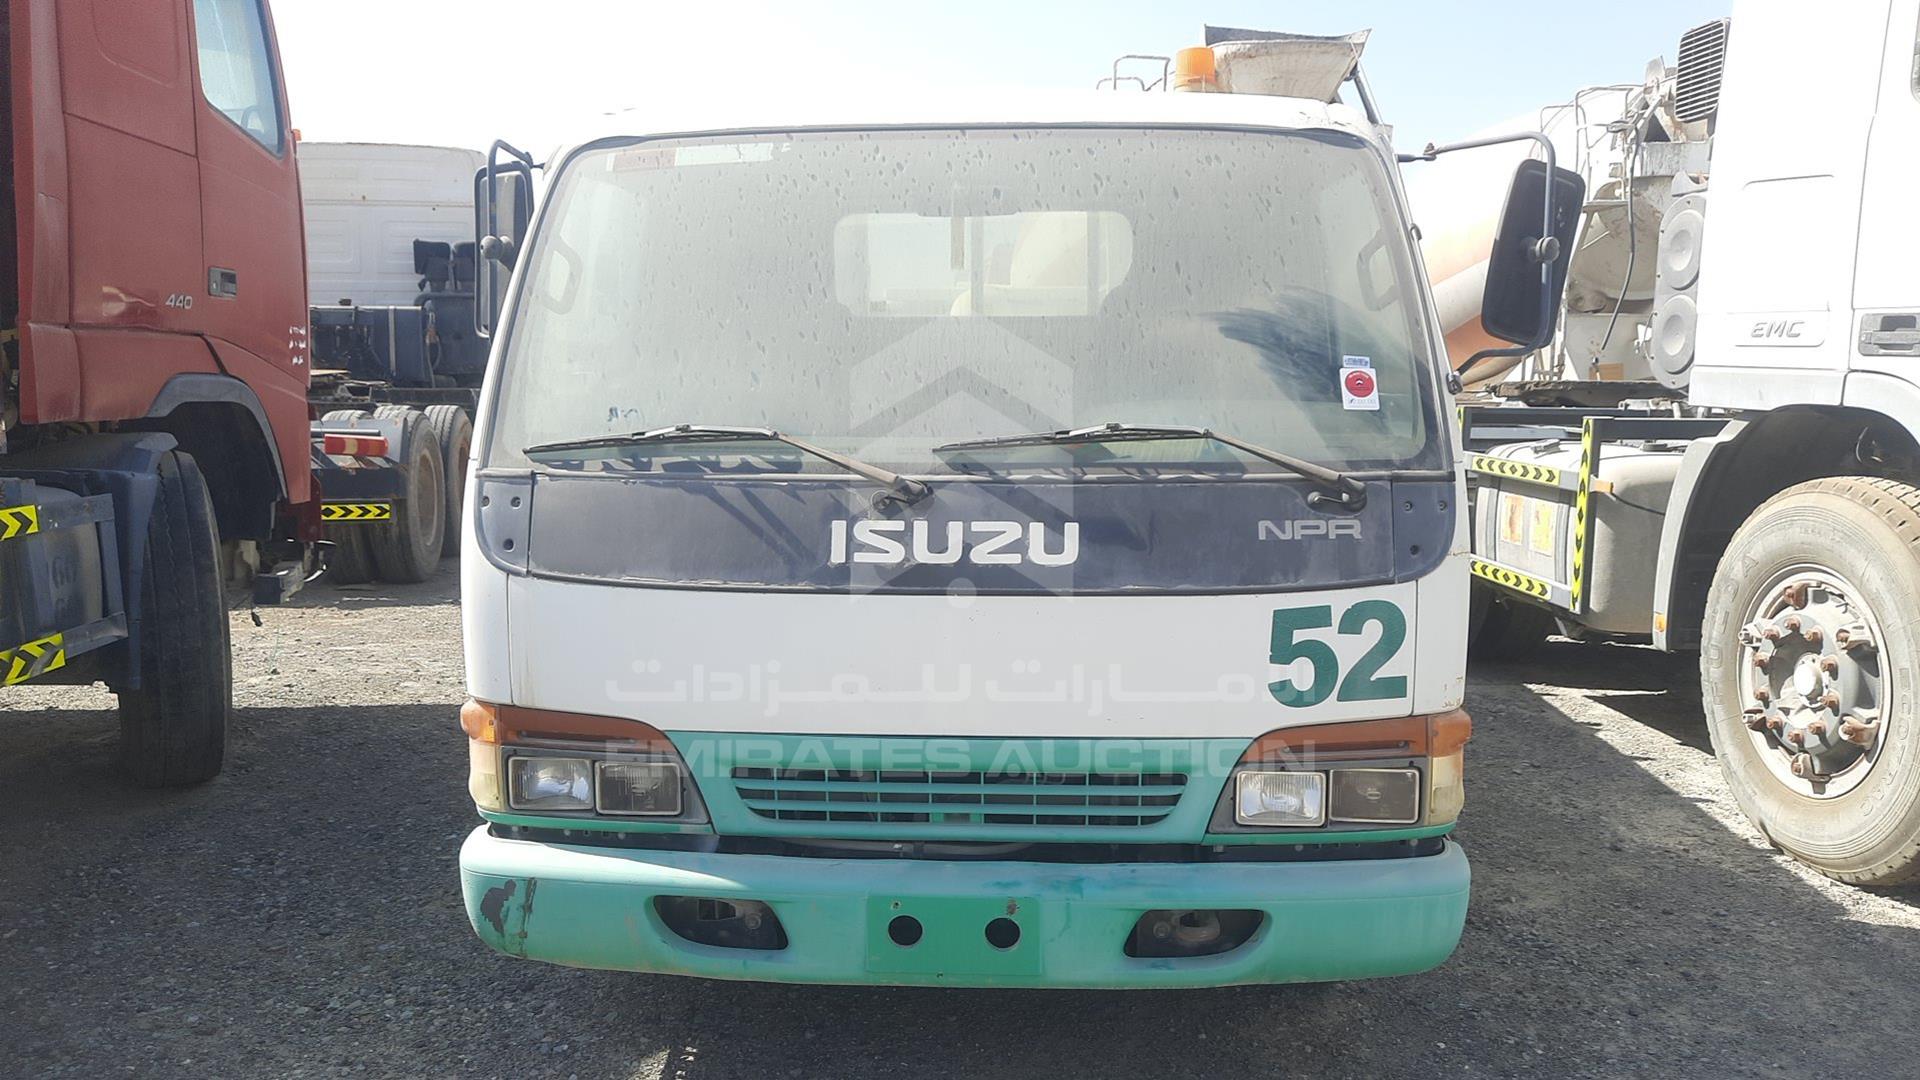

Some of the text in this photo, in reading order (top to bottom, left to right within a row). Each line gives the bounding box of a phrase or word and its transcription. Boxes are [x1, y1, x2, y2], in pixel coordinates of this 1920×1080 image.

[165, 294, 193, 310] 440
[1751, 319, 1805, 338] EMC
[1257, 519, 1363, 541] NPR
[830, 519, 1080, 566] ISUZU
[1267, 599, 1408, 709] 52
